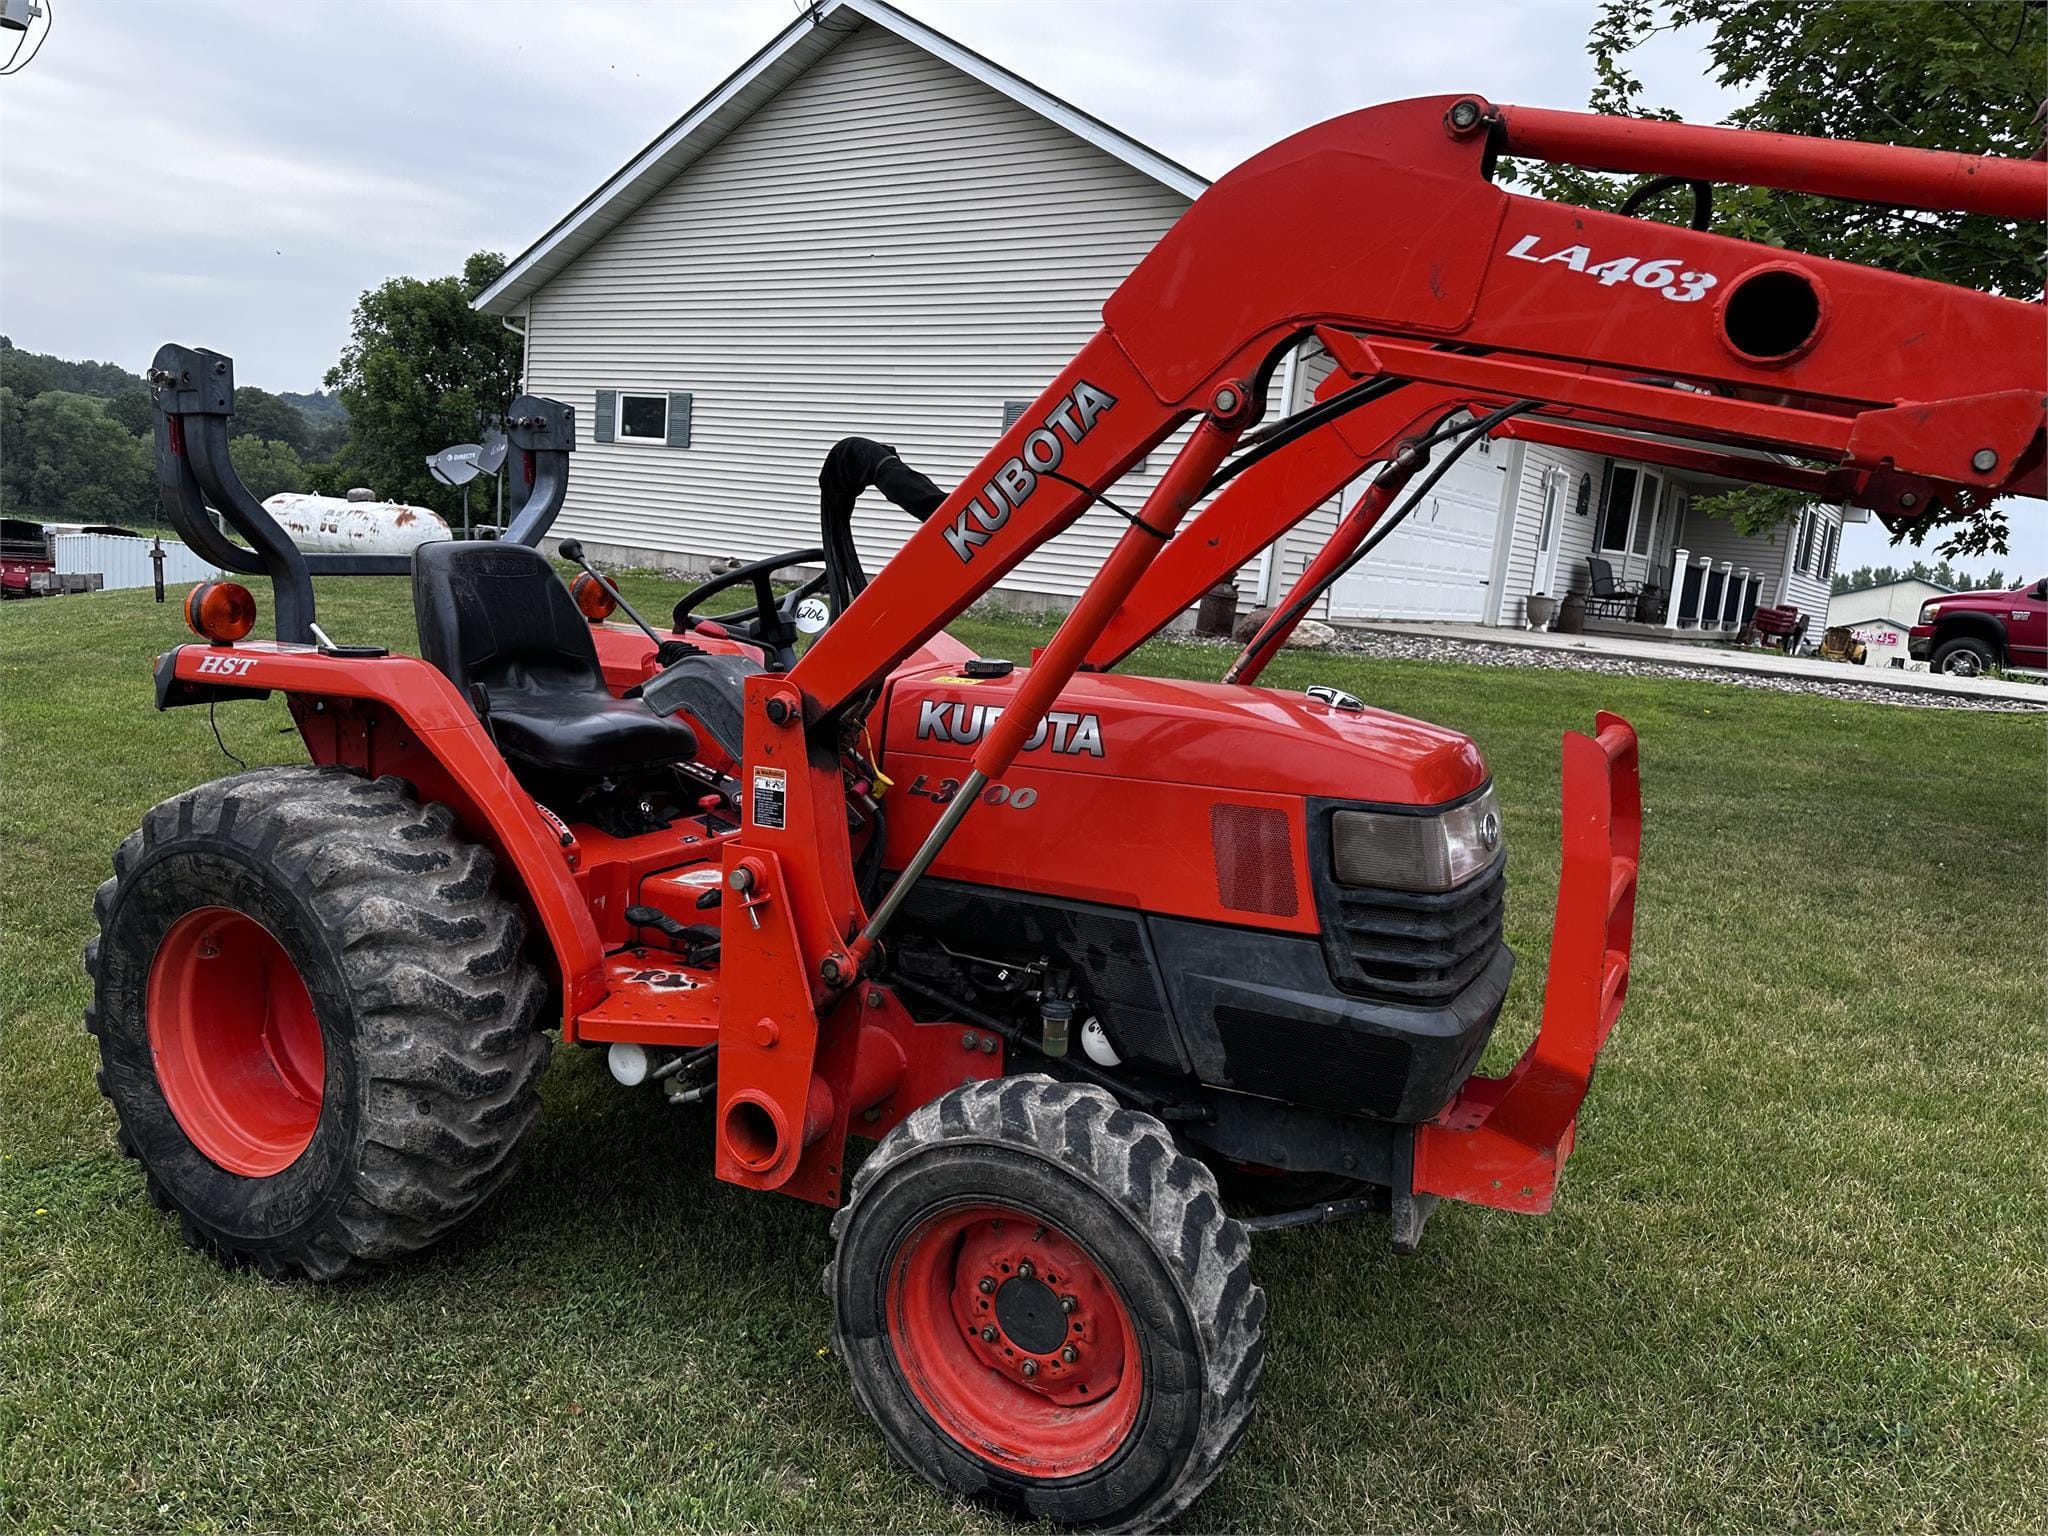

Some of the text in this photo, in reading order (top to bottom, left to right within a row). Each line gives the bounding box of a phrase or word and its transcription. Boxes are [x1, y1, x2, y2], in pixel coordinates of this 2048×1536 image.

[1505, 234, 1718, 302] LA463
[942, 379, 1119, 565] KUBOTA
[797, 606, 825, 621] 6706
[195, 655, 260, 676] HST
[917, 699, 1105, 758] KUTA
[907, 774, 1038, 809] L300
